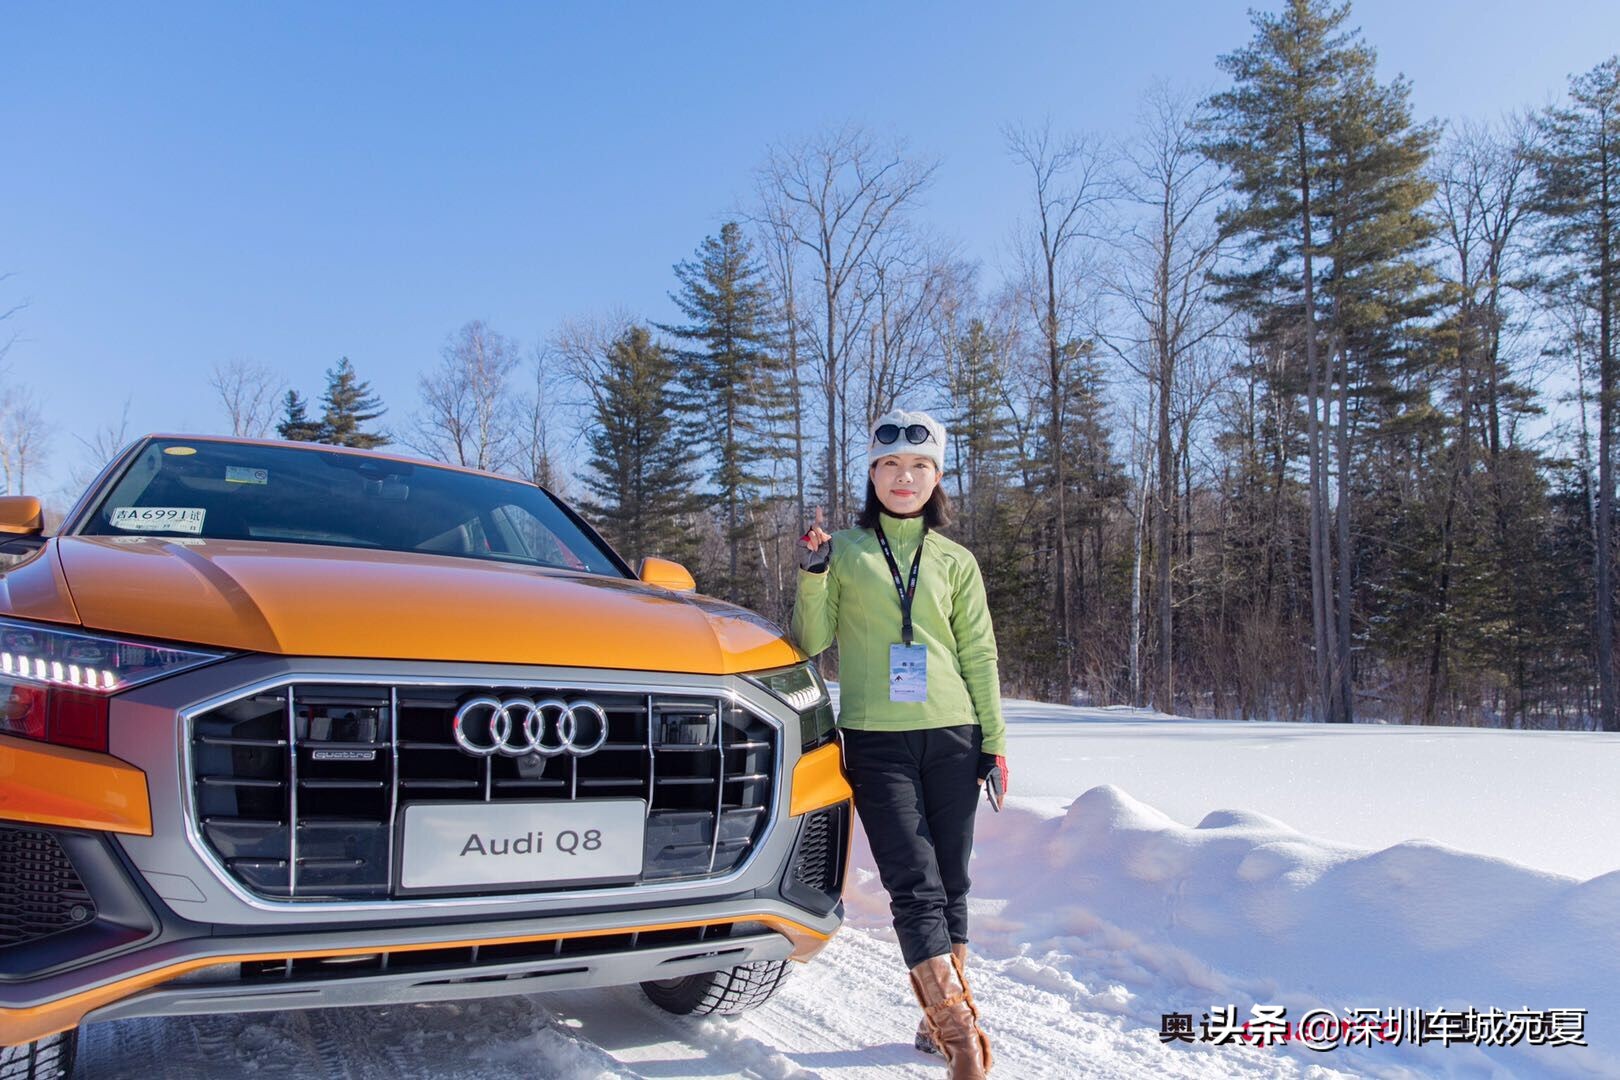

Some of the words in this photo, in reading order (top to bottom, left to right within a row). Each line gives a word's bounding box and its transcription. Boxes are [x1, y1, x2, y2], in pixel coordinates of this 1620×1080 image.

[315, 751, 373, 759] quattro
[460, 831, 543, 856] Audi
[556, 829, 602, 855] Q8
